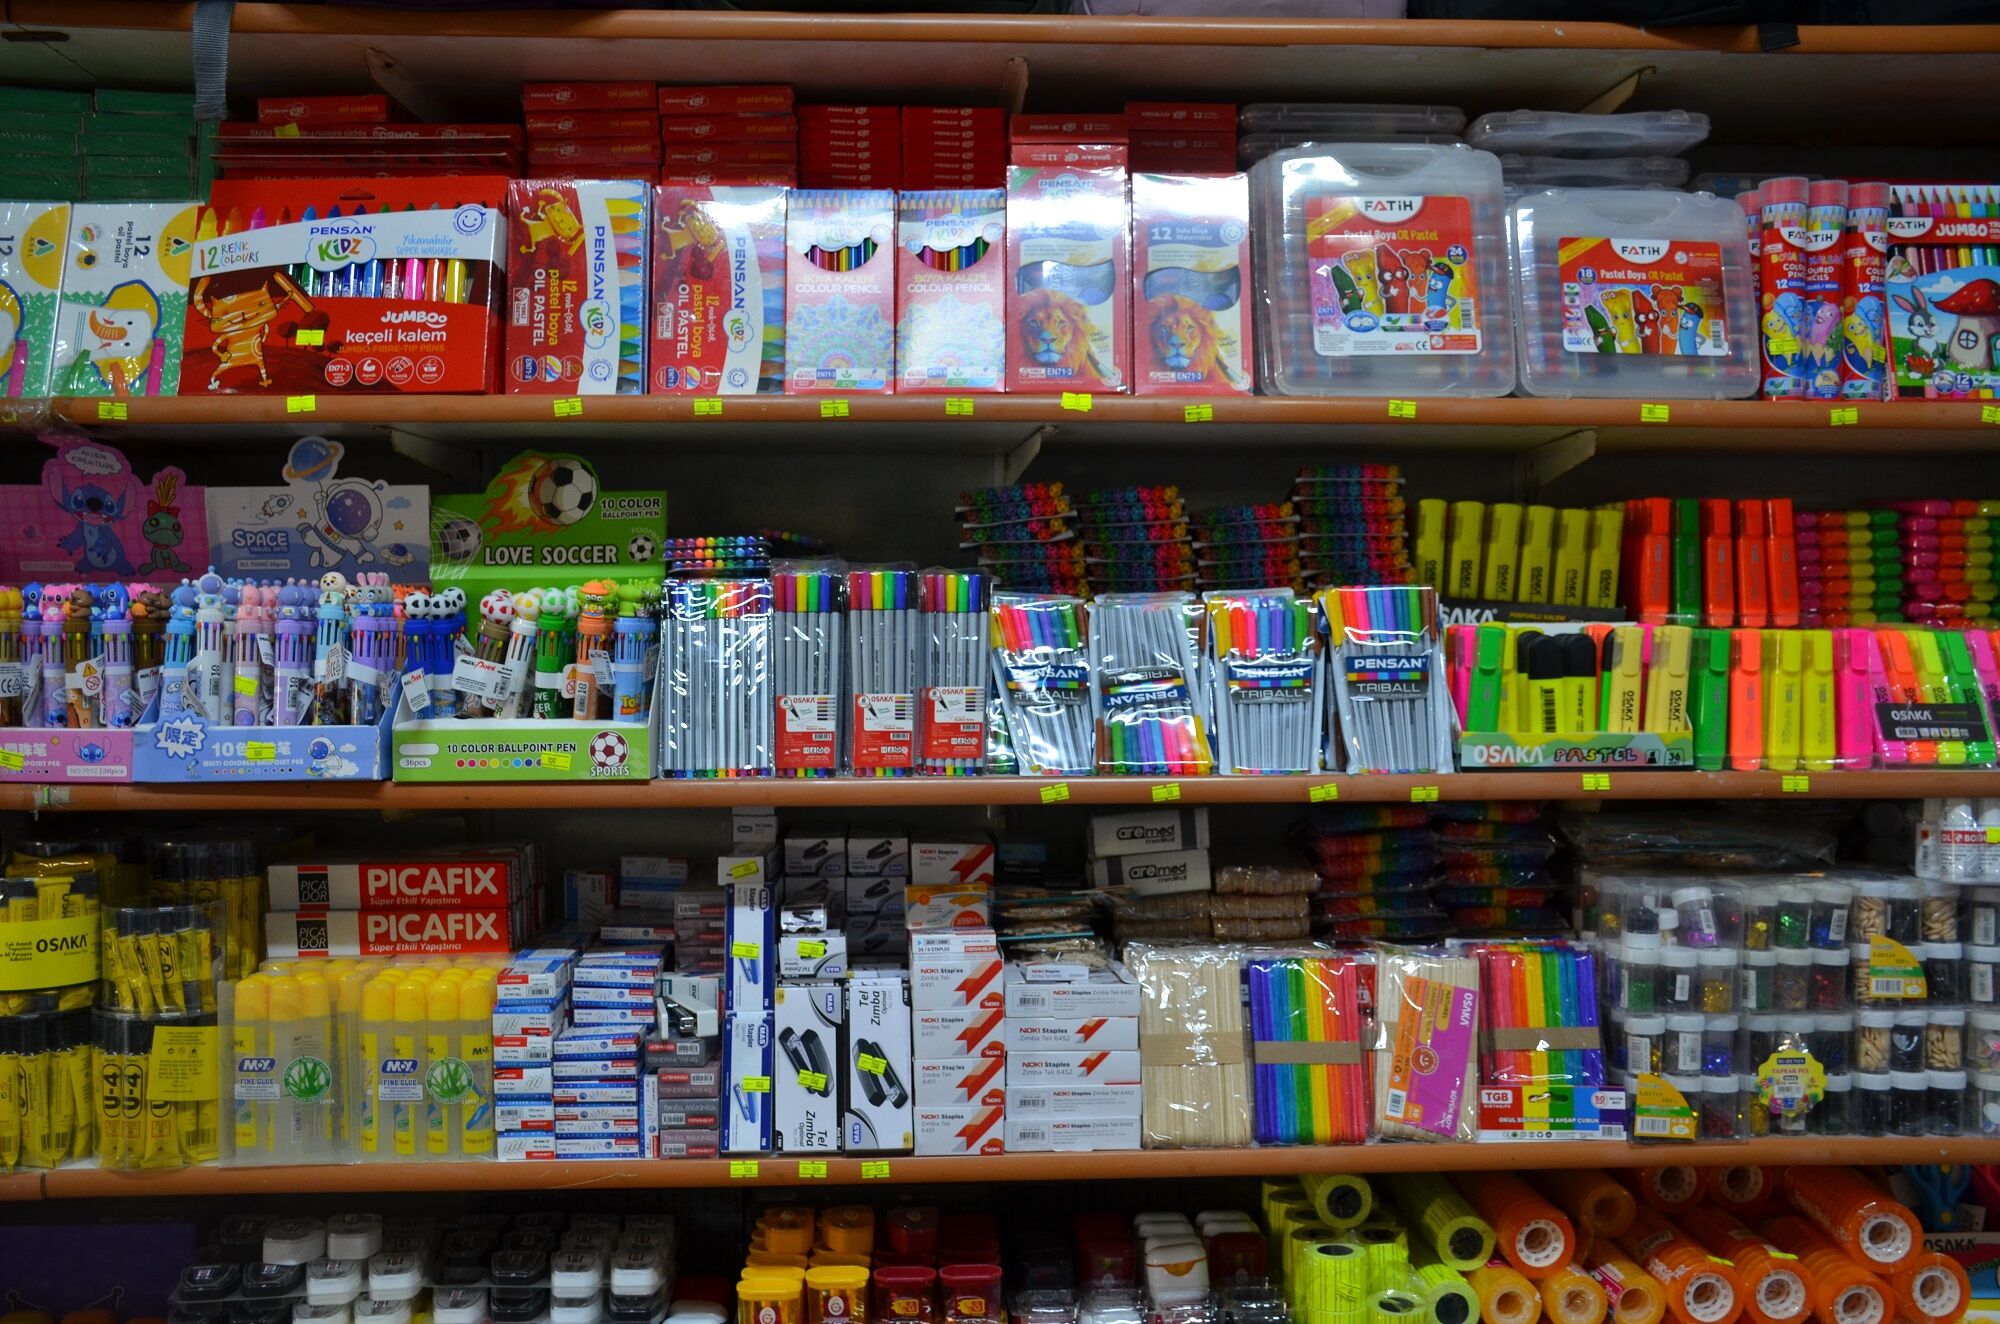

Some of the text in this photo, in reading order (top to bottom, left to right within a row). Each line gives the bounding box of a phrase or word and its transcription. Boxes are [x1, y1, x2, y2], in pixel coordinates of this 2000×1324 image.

[926, 219, 975, 227] PENSAN
[310, 226, 373, 235] PENSAN
[1152, 228, 1172, 240] 12
[1374, 230, 1397, 241] Boya
[1411, 230, 1439, 240] Pastel
[1936, 224, 1988, 236] JUMBO
[122, 221, 134, 268] pastel boya
[134, 235, 151, 256] 12
[221, 241, 249, 254] RENK
[114, 239, 122, 263] pastel
[1450, 247, 1463, 255] 24
[200, 249, 218, 271] 12
[221, 252, 260, 265] COLOURS
[594, 226, 605, 300] PENSAN
[735, 237, 746, 309] PENSAN
[1580, 269, 1593, 277] 18
[1600, 269, 1685, 281] Pastel Boya Pastel
[562, 280, 577, 292] 12
[796, 284, 882, 294] COLOUR PENCIL
[907, 283, 993, 293] COLOUR PENCIL
[1776, 279, 1788, 289] 12
[1858, 283, 1870, 293] 12
[547, 269, 560, 345] pastel boya
[706, 296, 720, 306] 12
[533, 269, 545, 346] OIL PASTEL
[677, 284, 690, 359] OIL PASTEL
[692, 284, 704, 358] pastel boya
[346, 329, 447, 345] keçeli kalem
[421, 344, 446, 352] PENS
[1047, 367, 1073, 376] EN71-3
[1176, 372, 1202, 380] EN71-3
[1956, 375, 1970, 384] 12
[81, 450, 107, 460] ALIEN
[71, 456, 115, 471] CREATURE
[601, 499, 660, 510] 10 COLOR
[603, 511, 642, 519] BALLPOINT
[233, 529, 288, 547] SPACE
[484, 545, 618, 565] LOVE SOCCER
[1500, 564, 1509, 594] OSAKA
[1535, 566, 1543, 597] OSAKA
[1570, 569, 1578, 599] OSAKA
[1604, 569, 1612, 599] OSAKA
[1354, 658, 1423, 669] PENSAN
[1236, 667, 1304, 678] PENSAN
[1238, 690, 1303, 698] TRIBALL
[1356, 683, 1421, 693] TRIBALL
[1109, 689, 1178, 706] PENSAN
[1626, 690, 1634, 722] OSAKA
[1674, 690, 1682, 722] OSAKA
[1891, 710, 1932, 720] OSAKA
[164, 726, 198, 747] 限定
[447, 743, 576, 753] 10 COLOR BALLPOINT PEN
[1473, 746, 1681, 763] OSAKA PASTEL 36
[405, 759, 427, 767] 36pcs
[590, 766, 630, 776] SPORTS
[300, 880, 327, 891] PICA
[367, 867, 498, 896] PICAFIX
[302, 891, 327, 901] DOR
[370, 897, 393, 905] Süper
[420, 897, 461, 906] Yapıştırıcı
[299, 927, 326, 938] PICA
[367, 912, 499, 941] PICAFIX
[36, 934, 88, 953] OSAKA
[300, 937, 326, 948] DOR
[369, 943, 461, 952] Süper Etkili Yapıştırıcı
[826, 994, 834, 1013] MAS
[859, 990, 869, 1006] Tel
[1460, 993, 1474, 1026] OSAKA
[759, 1026, 767, 1046] MAS
[1044, 1061, 1070, 1069] Staples
[104, 1072, 119, 1110] U-4
[124, 1072, 140, 1110] U-4
[1486, 1092, 1508, 1101] TGB
[817, 1129, 828, 1147] Tel
[744, 1165, 752, 1174] 100
